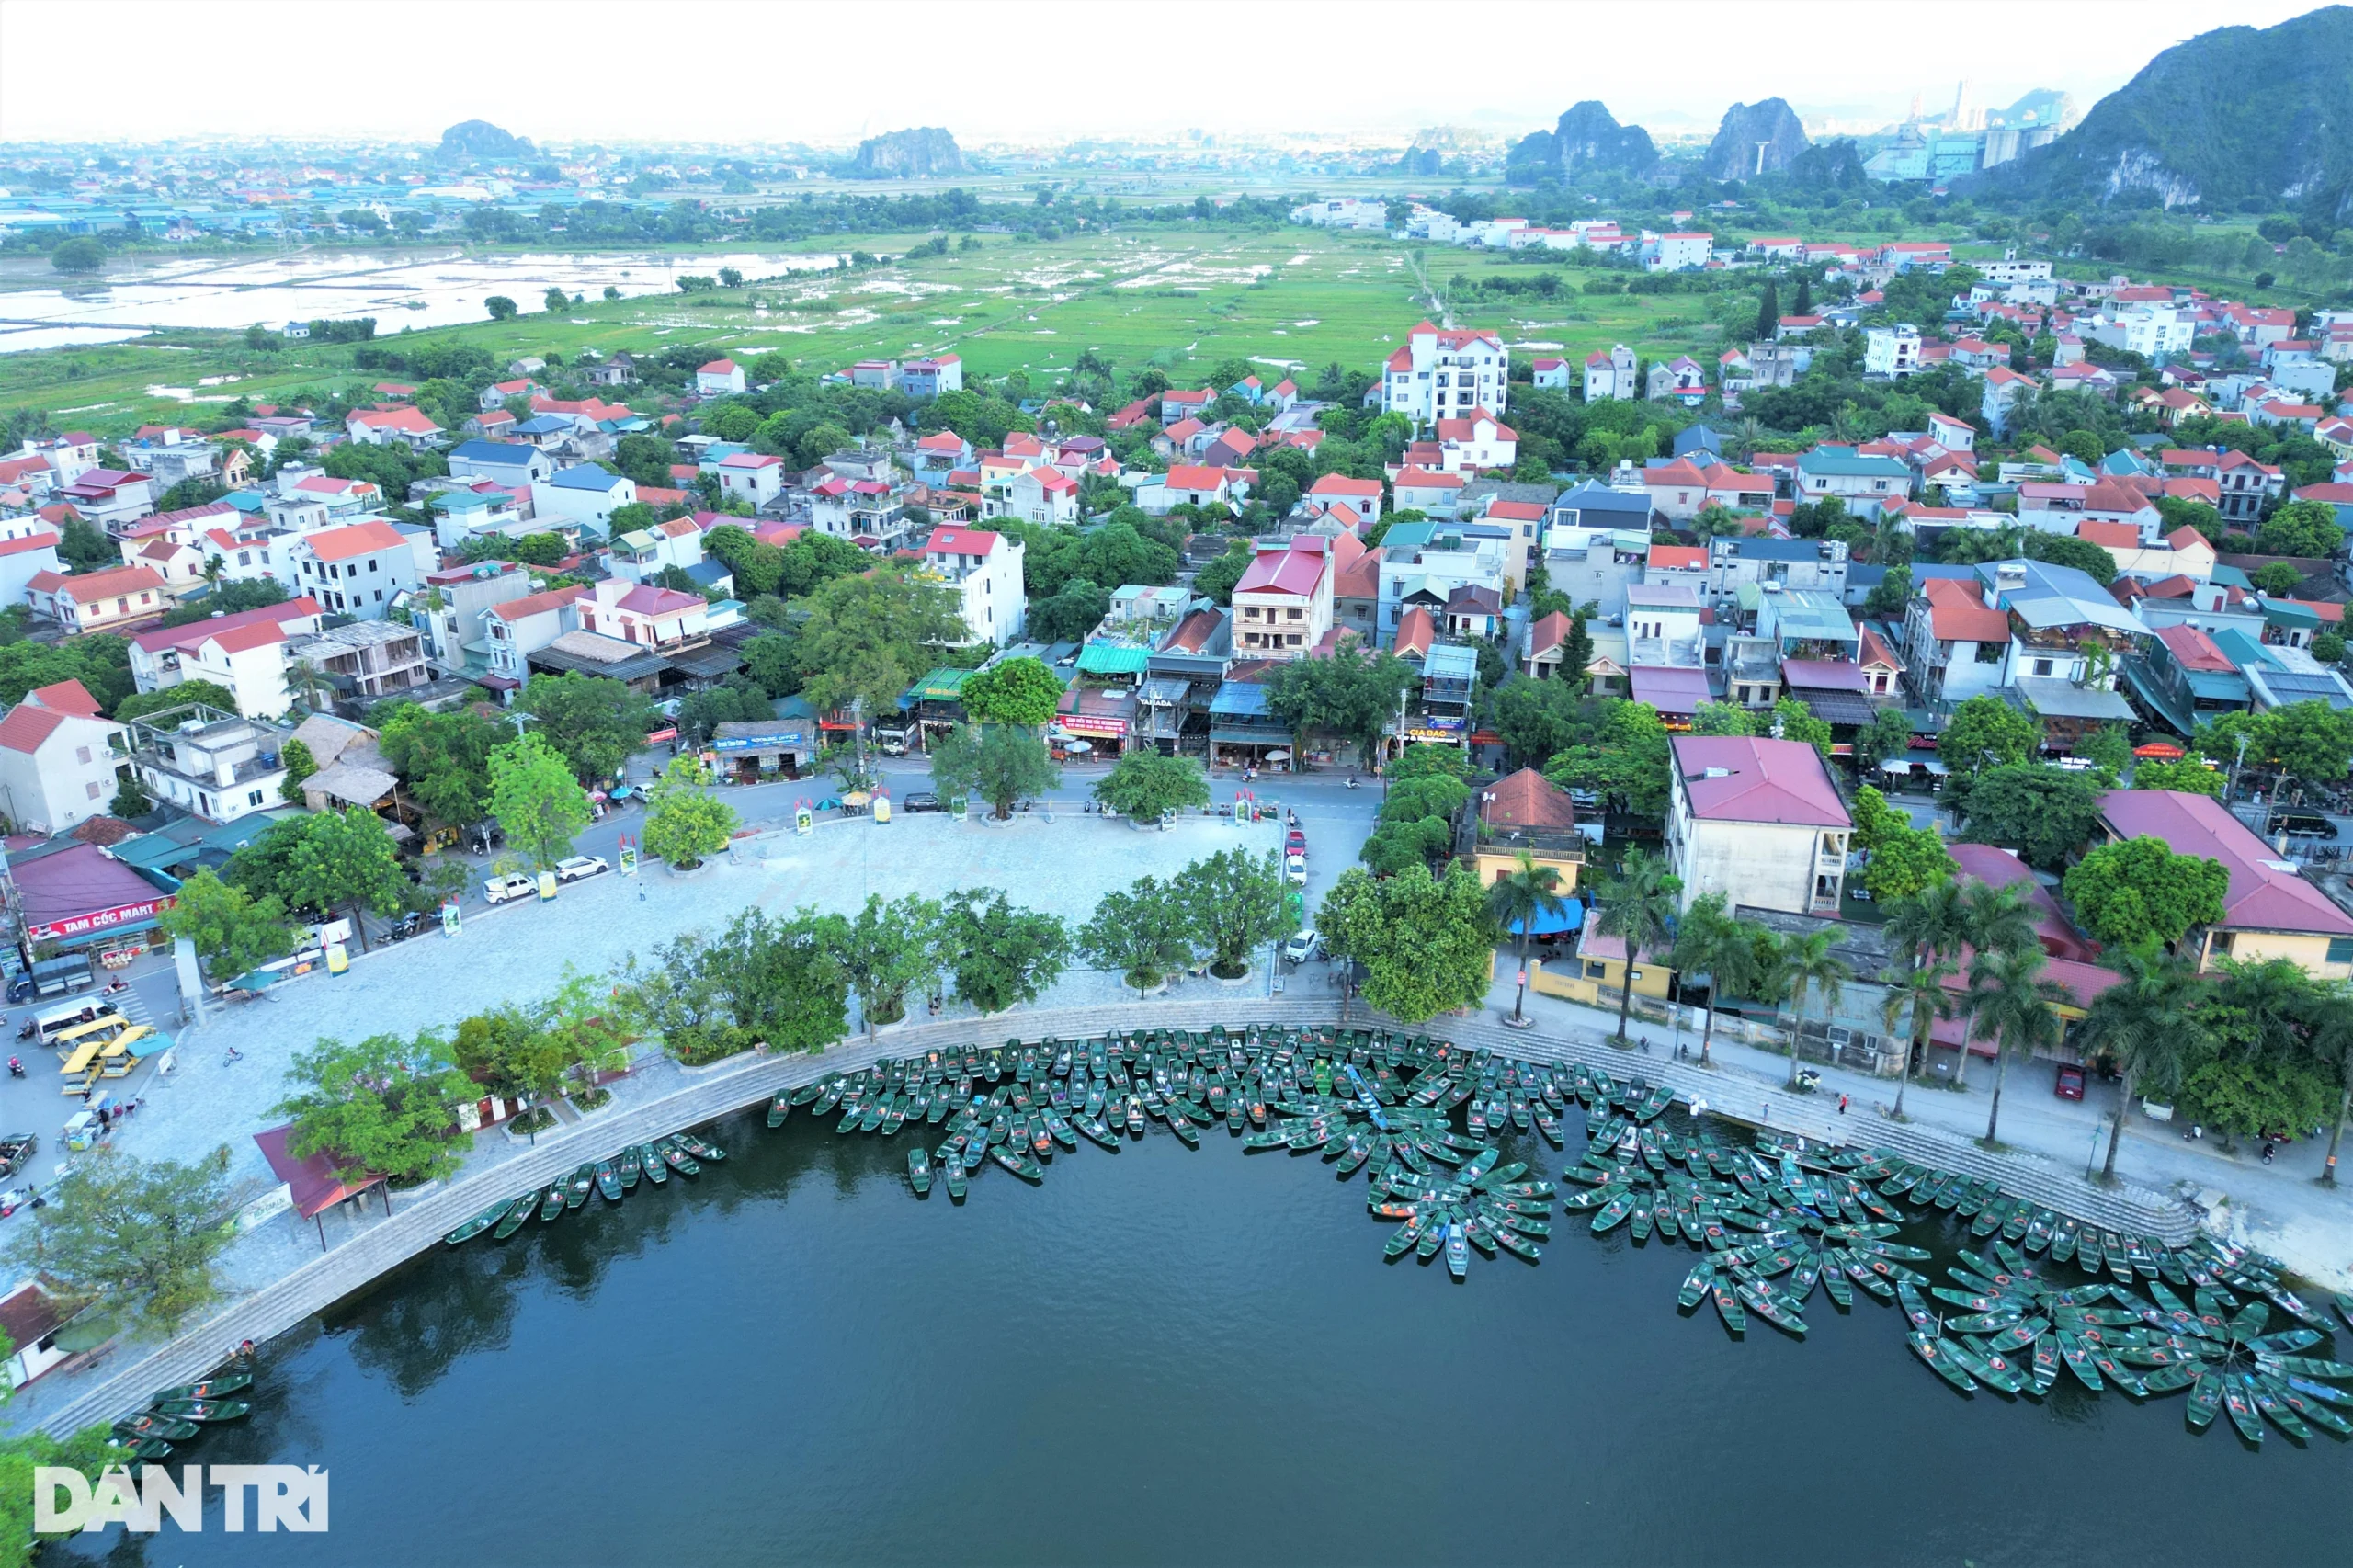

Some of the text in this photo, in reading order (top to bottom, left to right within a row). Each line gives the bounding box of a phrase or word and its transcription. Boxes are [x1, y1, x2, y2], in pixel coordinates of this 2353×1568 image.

[63, 921, 89, 933] TAM
[93, 911, 118, 926] CỐC
[120, 904, 153, 920] MART
